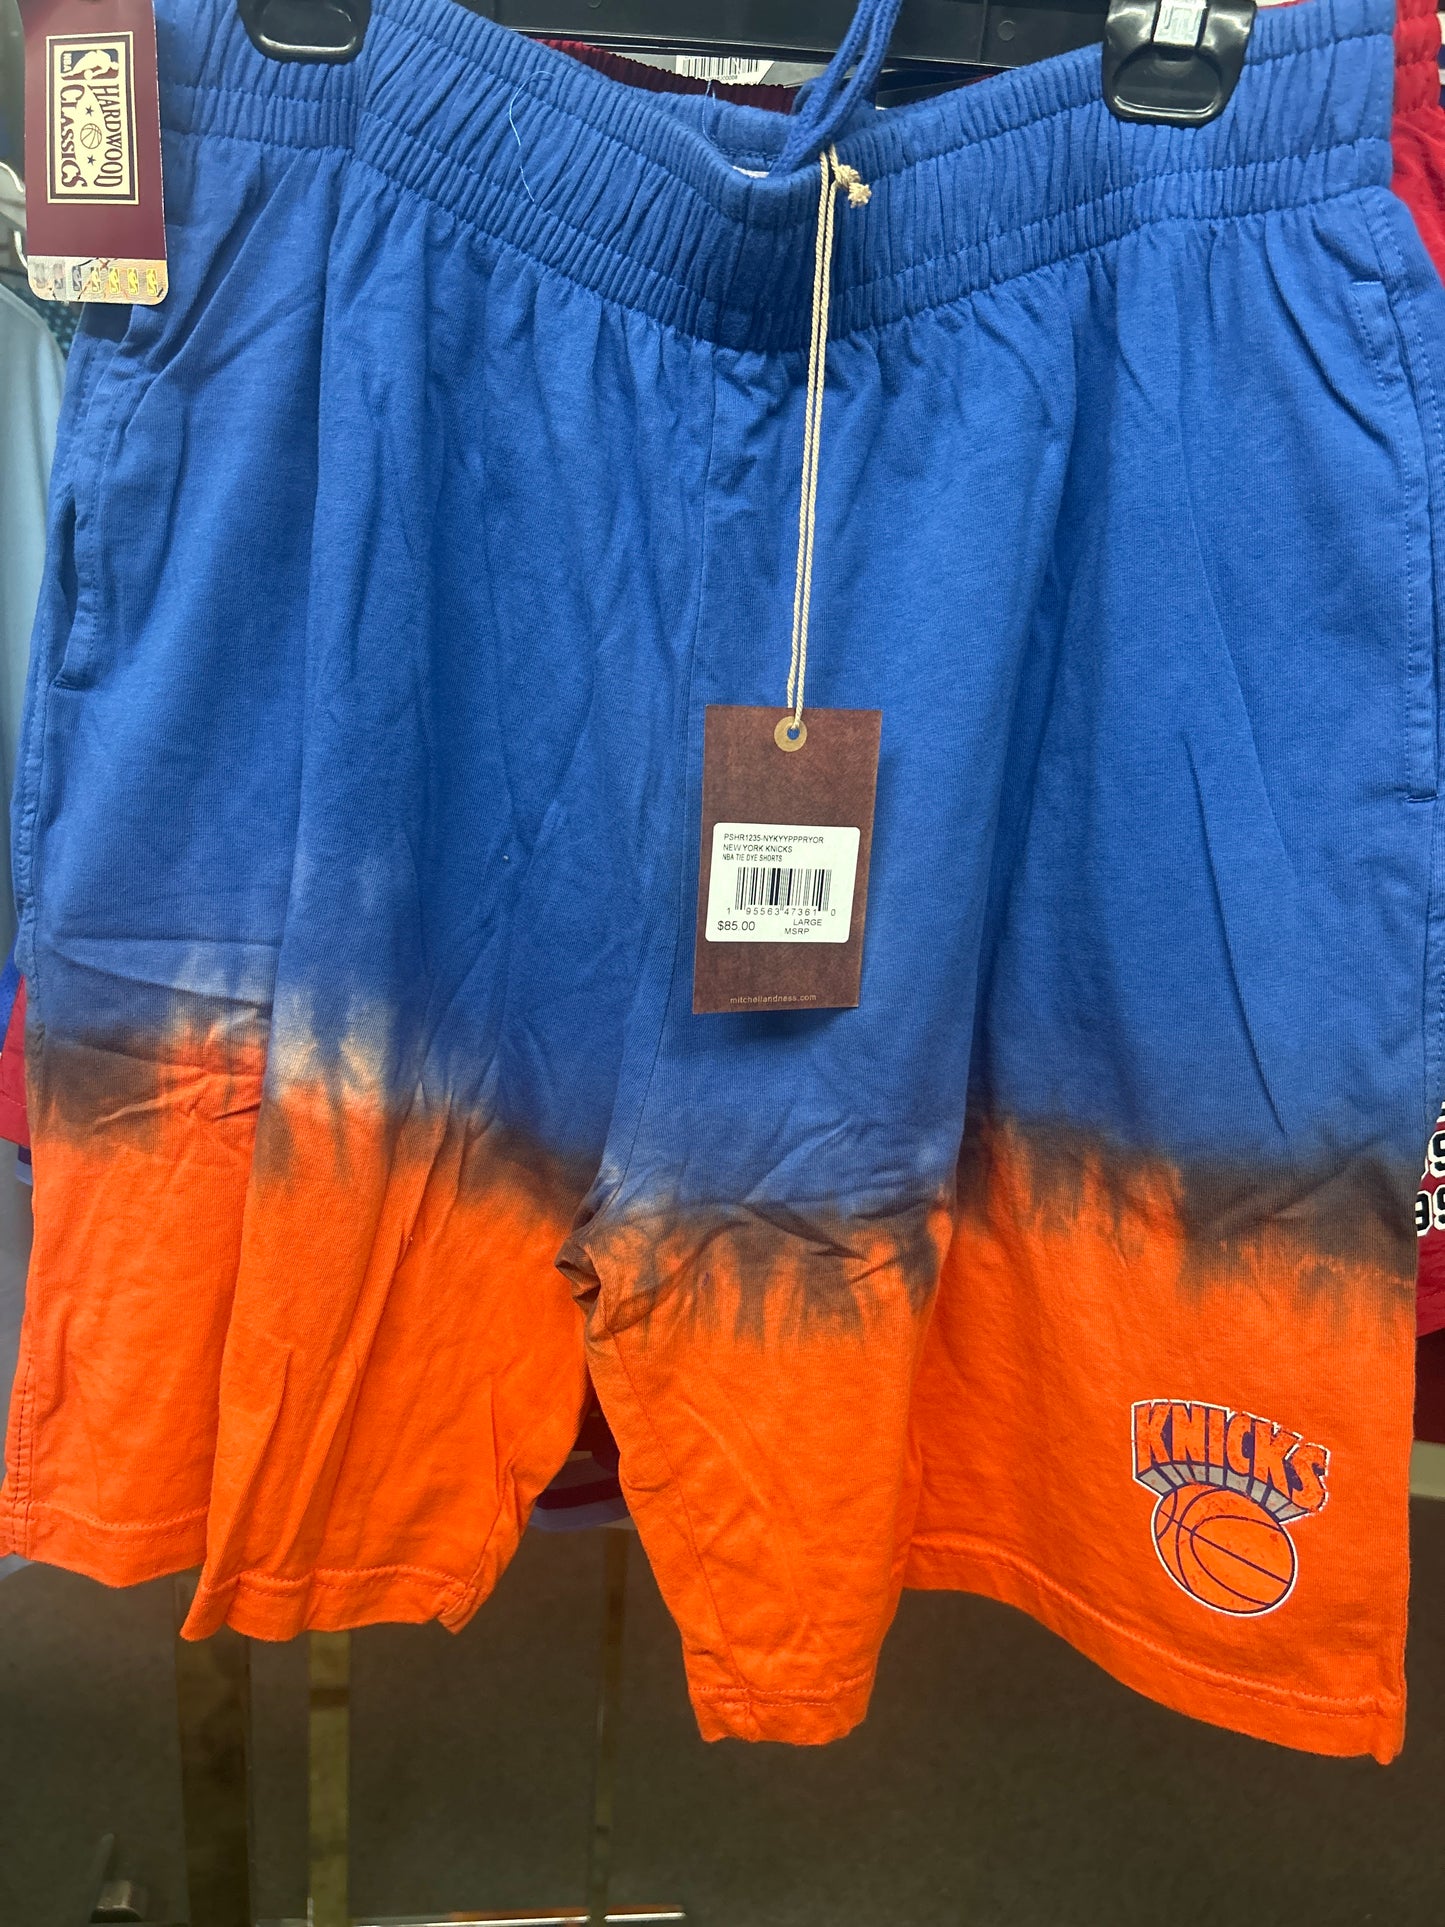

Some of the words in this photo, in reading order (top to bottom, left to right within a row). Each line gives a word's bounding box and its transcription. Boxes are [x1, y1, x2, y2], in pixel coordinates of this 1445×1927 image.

[62, 52, 73, 72] NBA
[60, 84, 88, 188] CLASSICS
[87, 83, 123, 188] HARDWOOD
[723, 844, 741, 852] NEW
[742, 844, 764, 852] YORK
[765, 845, 793, 853] KNICKS
[722, 853, 734, 861] NBA
[759, 854, 783, 862] SHORTS
[717, 920, 756, 931] $85.00
[793, 918, 822, 926] LARGE
[730, 994, 817, 1004] mitchellandness.com
[1132, 1399, 1331, 1517] KNICKS
